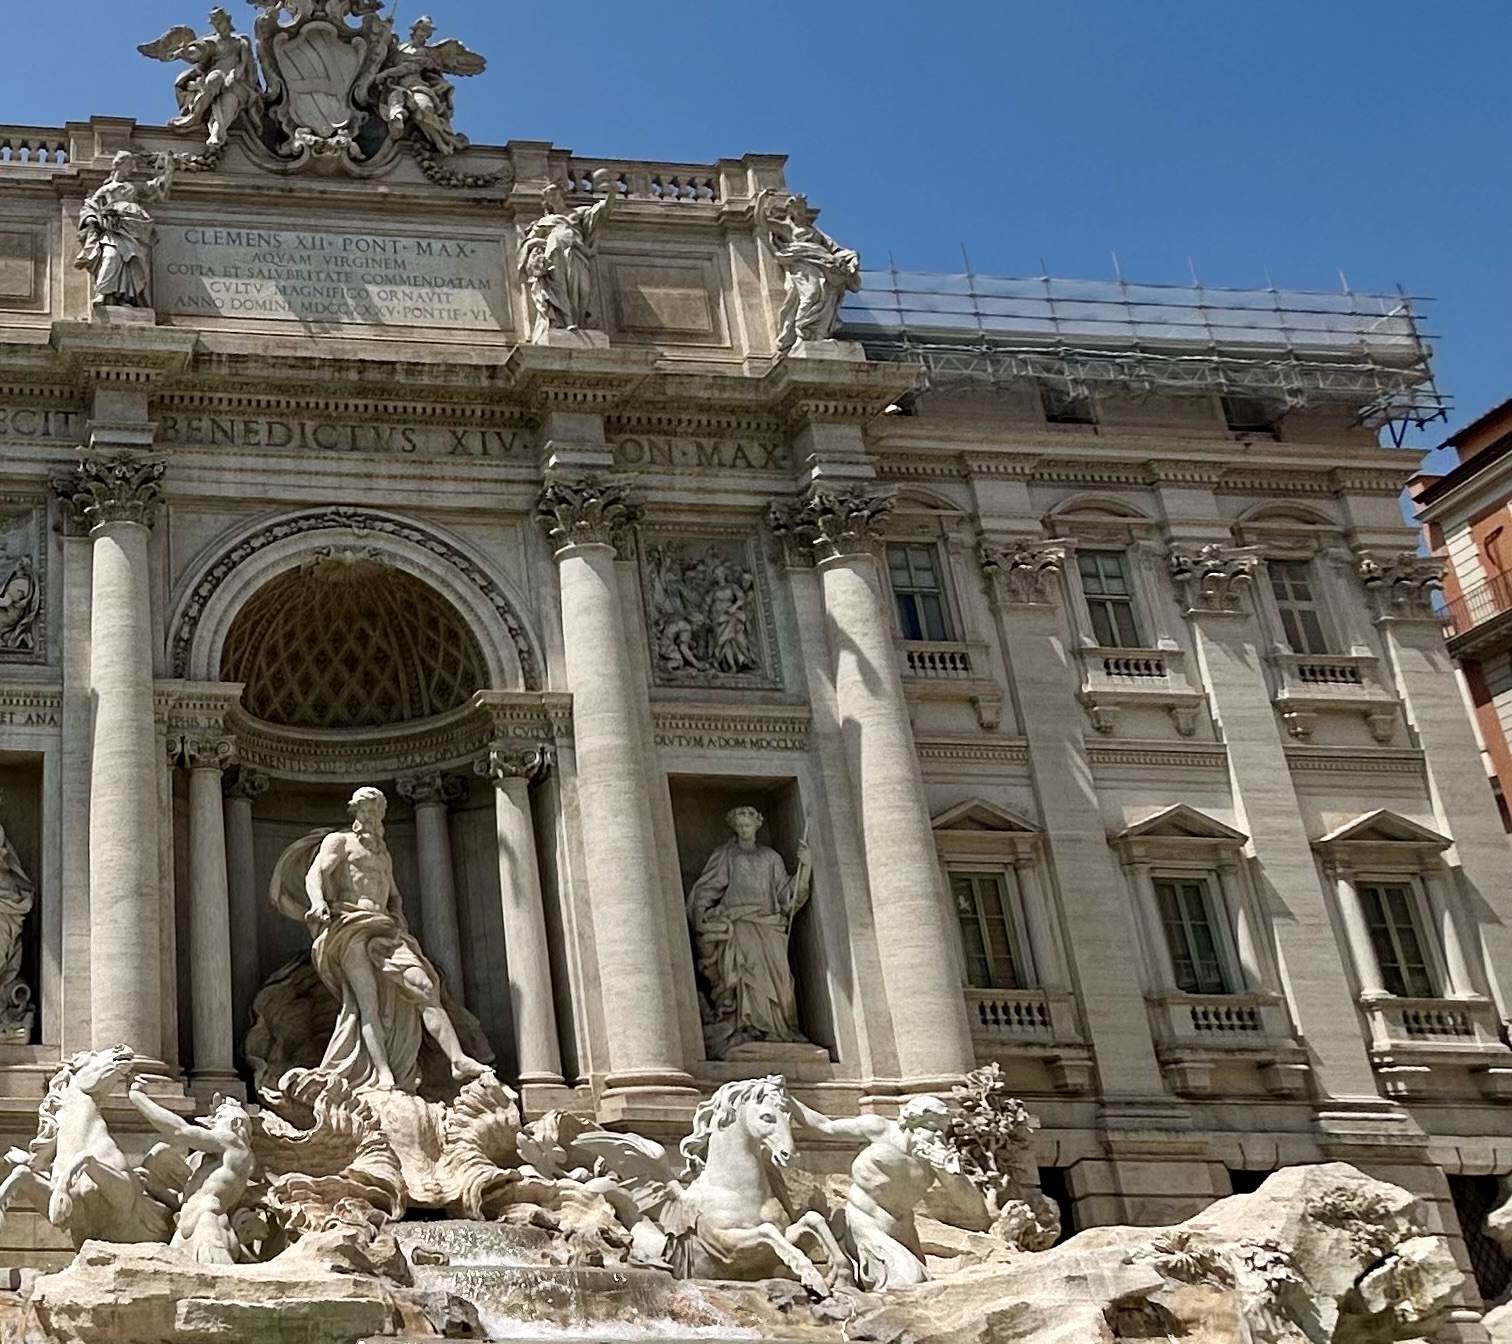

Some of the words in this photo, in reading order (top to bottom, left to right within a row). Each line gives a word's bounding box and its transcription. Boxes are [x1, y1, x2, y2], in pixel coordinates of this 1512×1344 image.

[184, 229, 282, 249] CLEMENS
[251, 253, 313, 267] AQVAM
[322, 256, 407, 271] VIRGINEM
[168, 263, 216, 276] COPIA
[223, 265, 241, 278] ET
[247, 267, 353, 283] SALVBRITATE
[361, 273, 492, 290] COMMENDATAM
[209, 281, 264, 295] CVLTV
[274, 285, 369, 300] MAGNIFICO
[377, 289, 454, 304] ORNAVIT
[175, 296, 225, 309] ANNO
[231, 298, 293, 312] DOMINI
[162, 416, 418, 454] BENEDICTVS
[0, 711, 16, 724] ET
[24, 712, 58, 726] ANA
